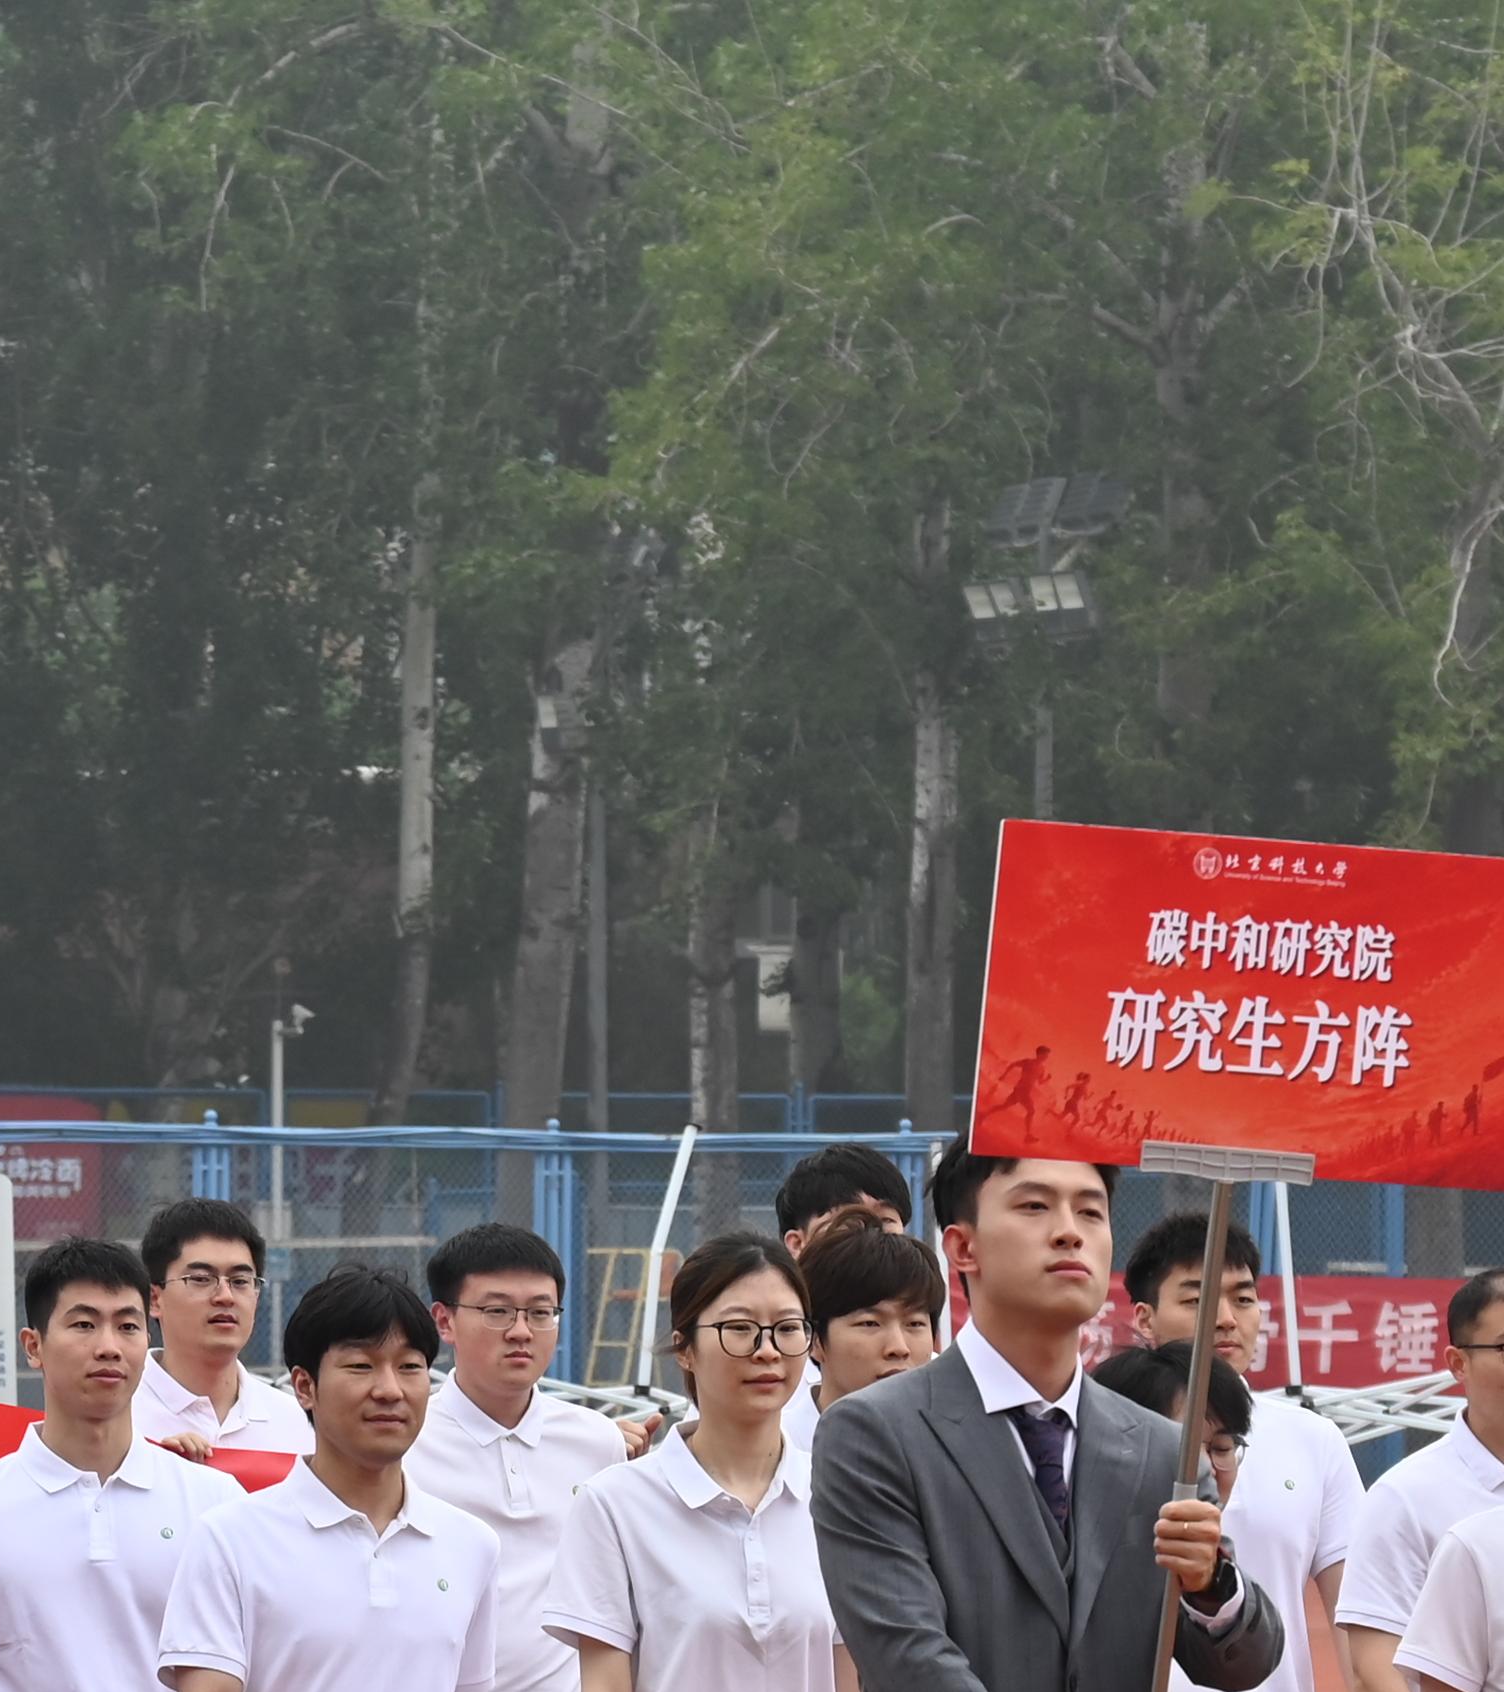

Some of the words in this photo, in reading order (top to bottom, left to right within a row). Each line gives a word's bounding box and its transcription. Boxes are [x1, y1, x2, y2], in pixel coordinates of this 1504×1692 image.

[1224, 853, 1348, 879] 北京科技大学
[1145, 908, 1395, 982] 碳中和研究院
[1102, 987, 1413, 1088] 研究生方阵
